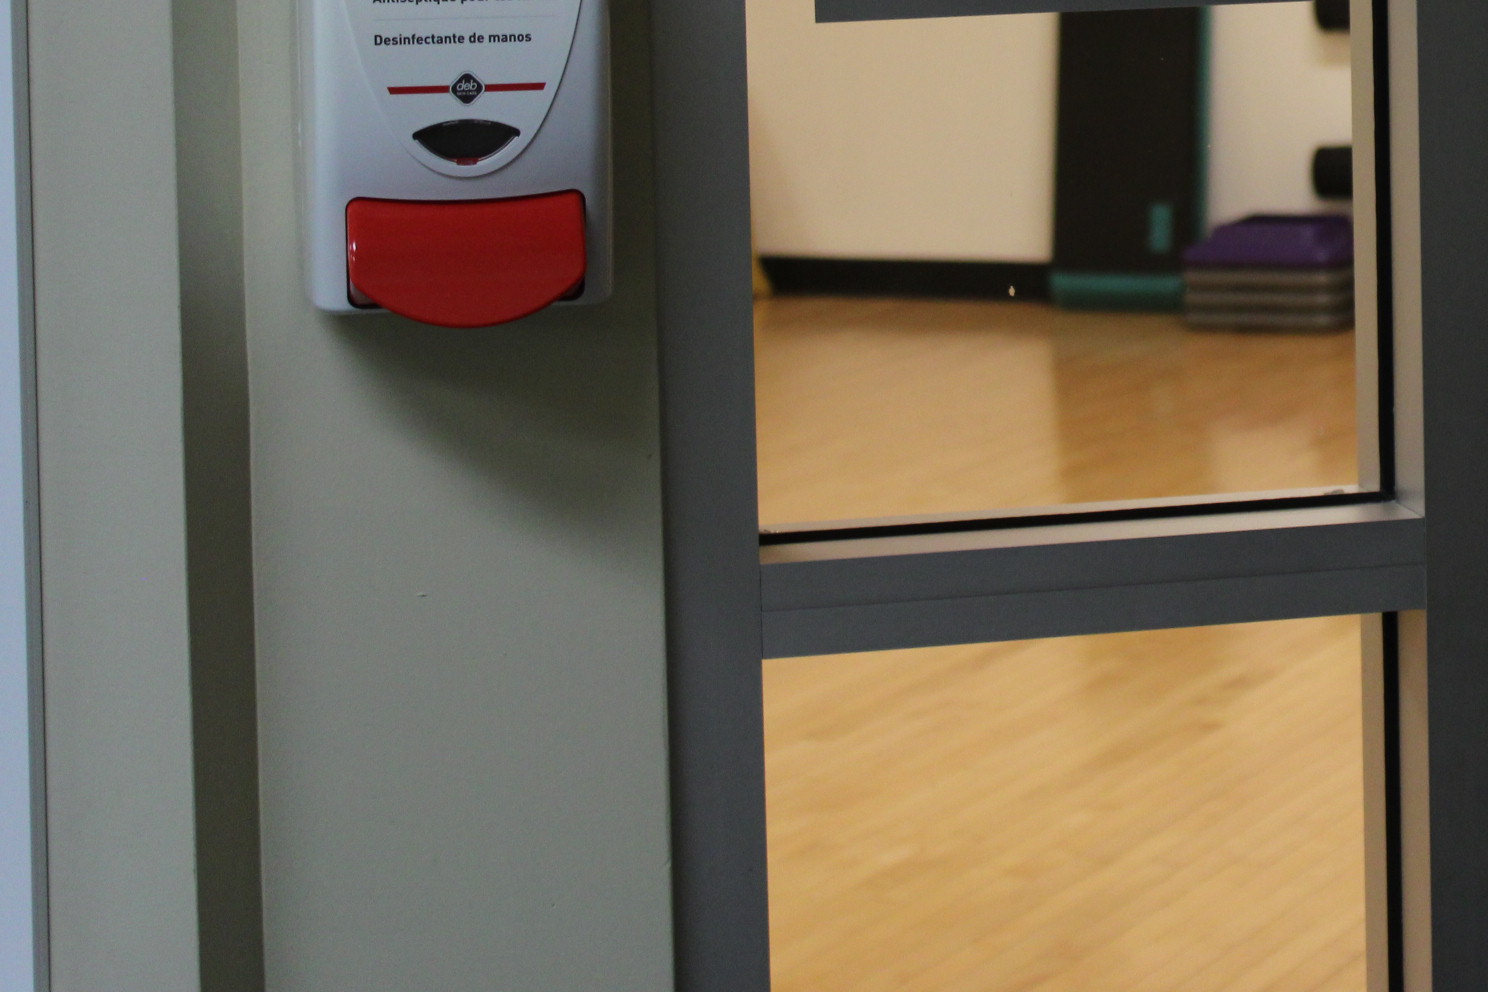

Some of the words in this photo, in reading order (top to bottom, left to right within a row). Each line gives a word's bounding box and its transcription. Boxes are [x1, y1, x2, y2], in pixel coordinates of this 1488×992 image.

[373, 33, 465, 46] Desinfectante
[468, 32, 485, 44] de
[488, 32, 532, 44] manos
[456, 79, 478, 91] deb
